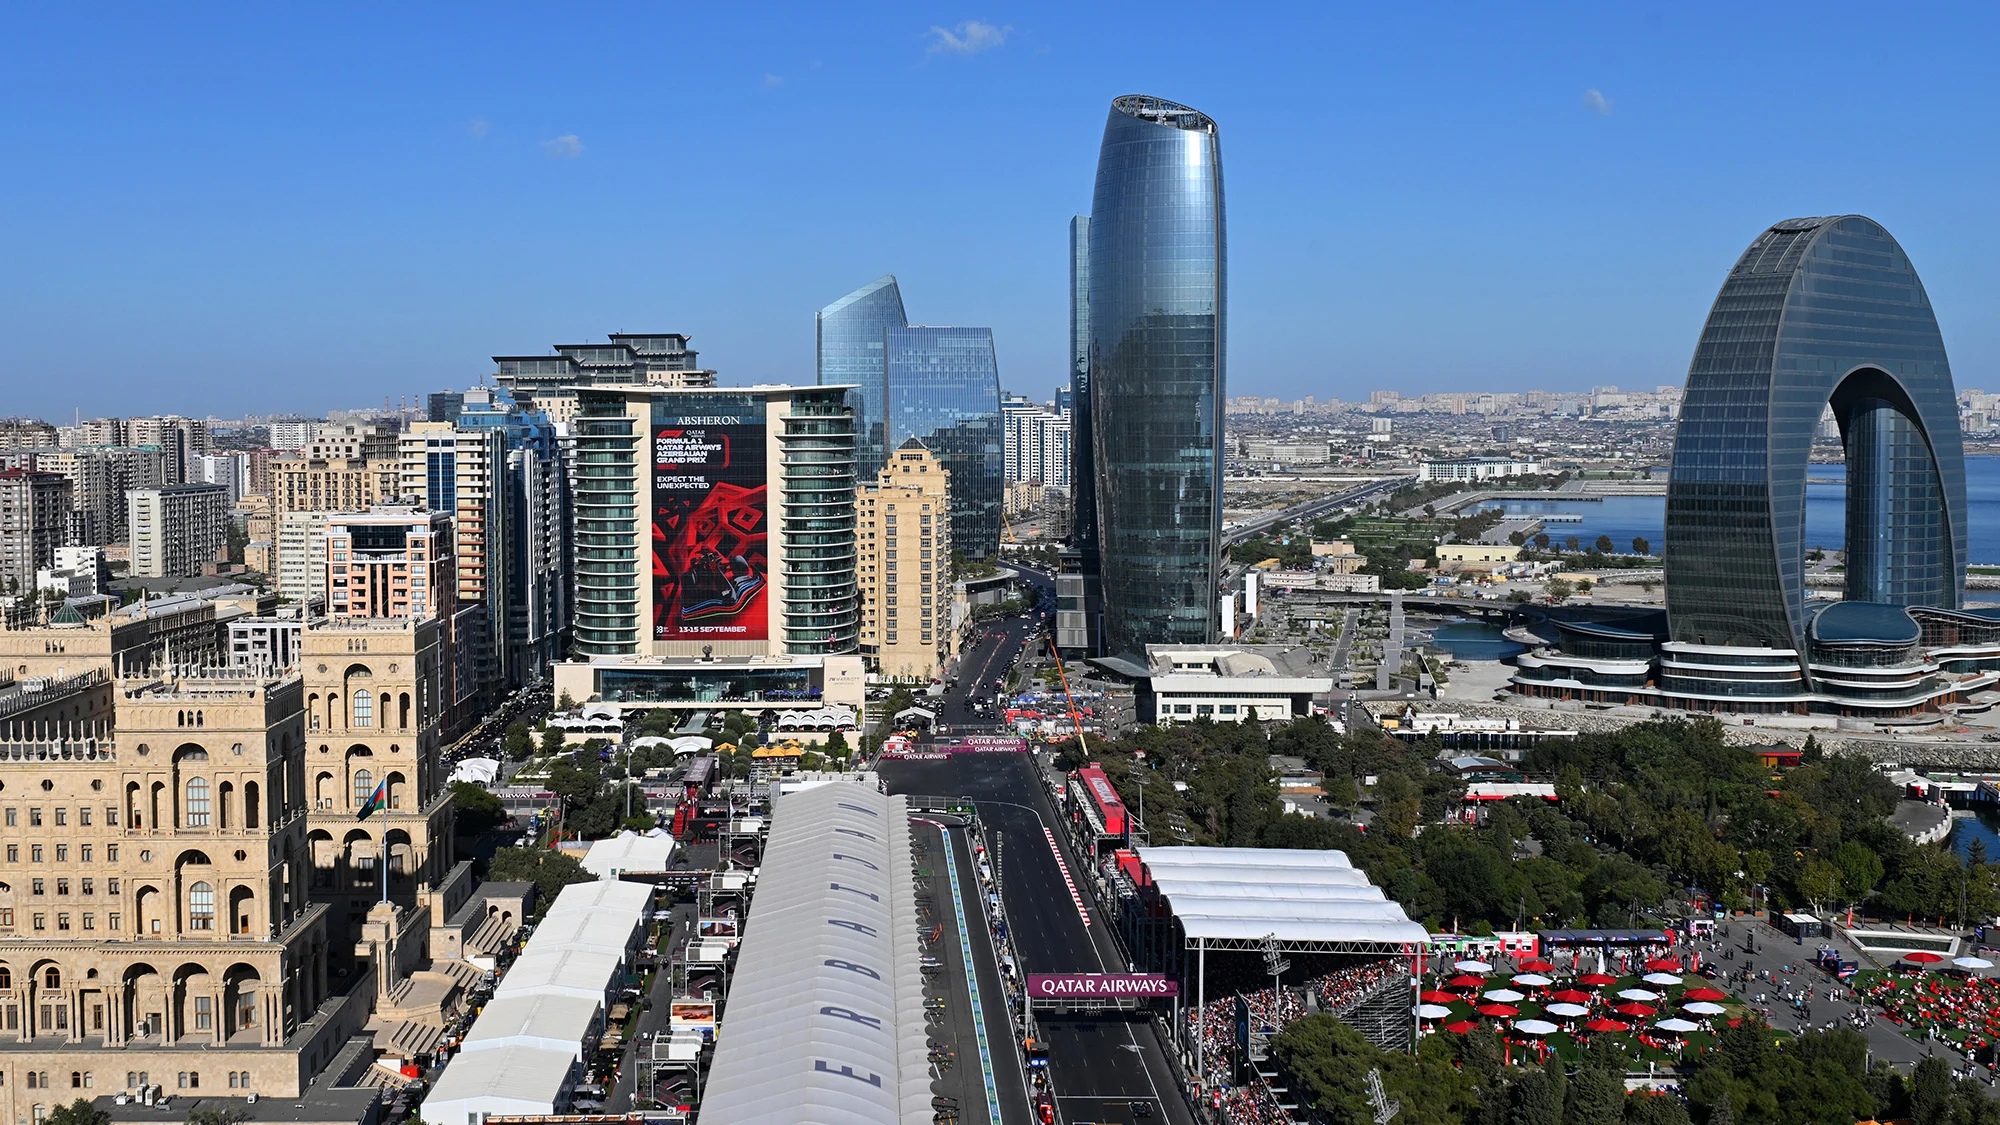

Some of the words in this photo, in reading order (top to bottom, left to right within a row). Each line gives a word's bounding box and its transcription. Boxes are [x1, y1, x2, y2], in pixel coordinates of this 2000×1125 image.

[677, 416, 740, 425] ABSHERON
[1041, 979, 1096, 995] QATAR
[1099, 979, 1167, 992] AIRWAYS
